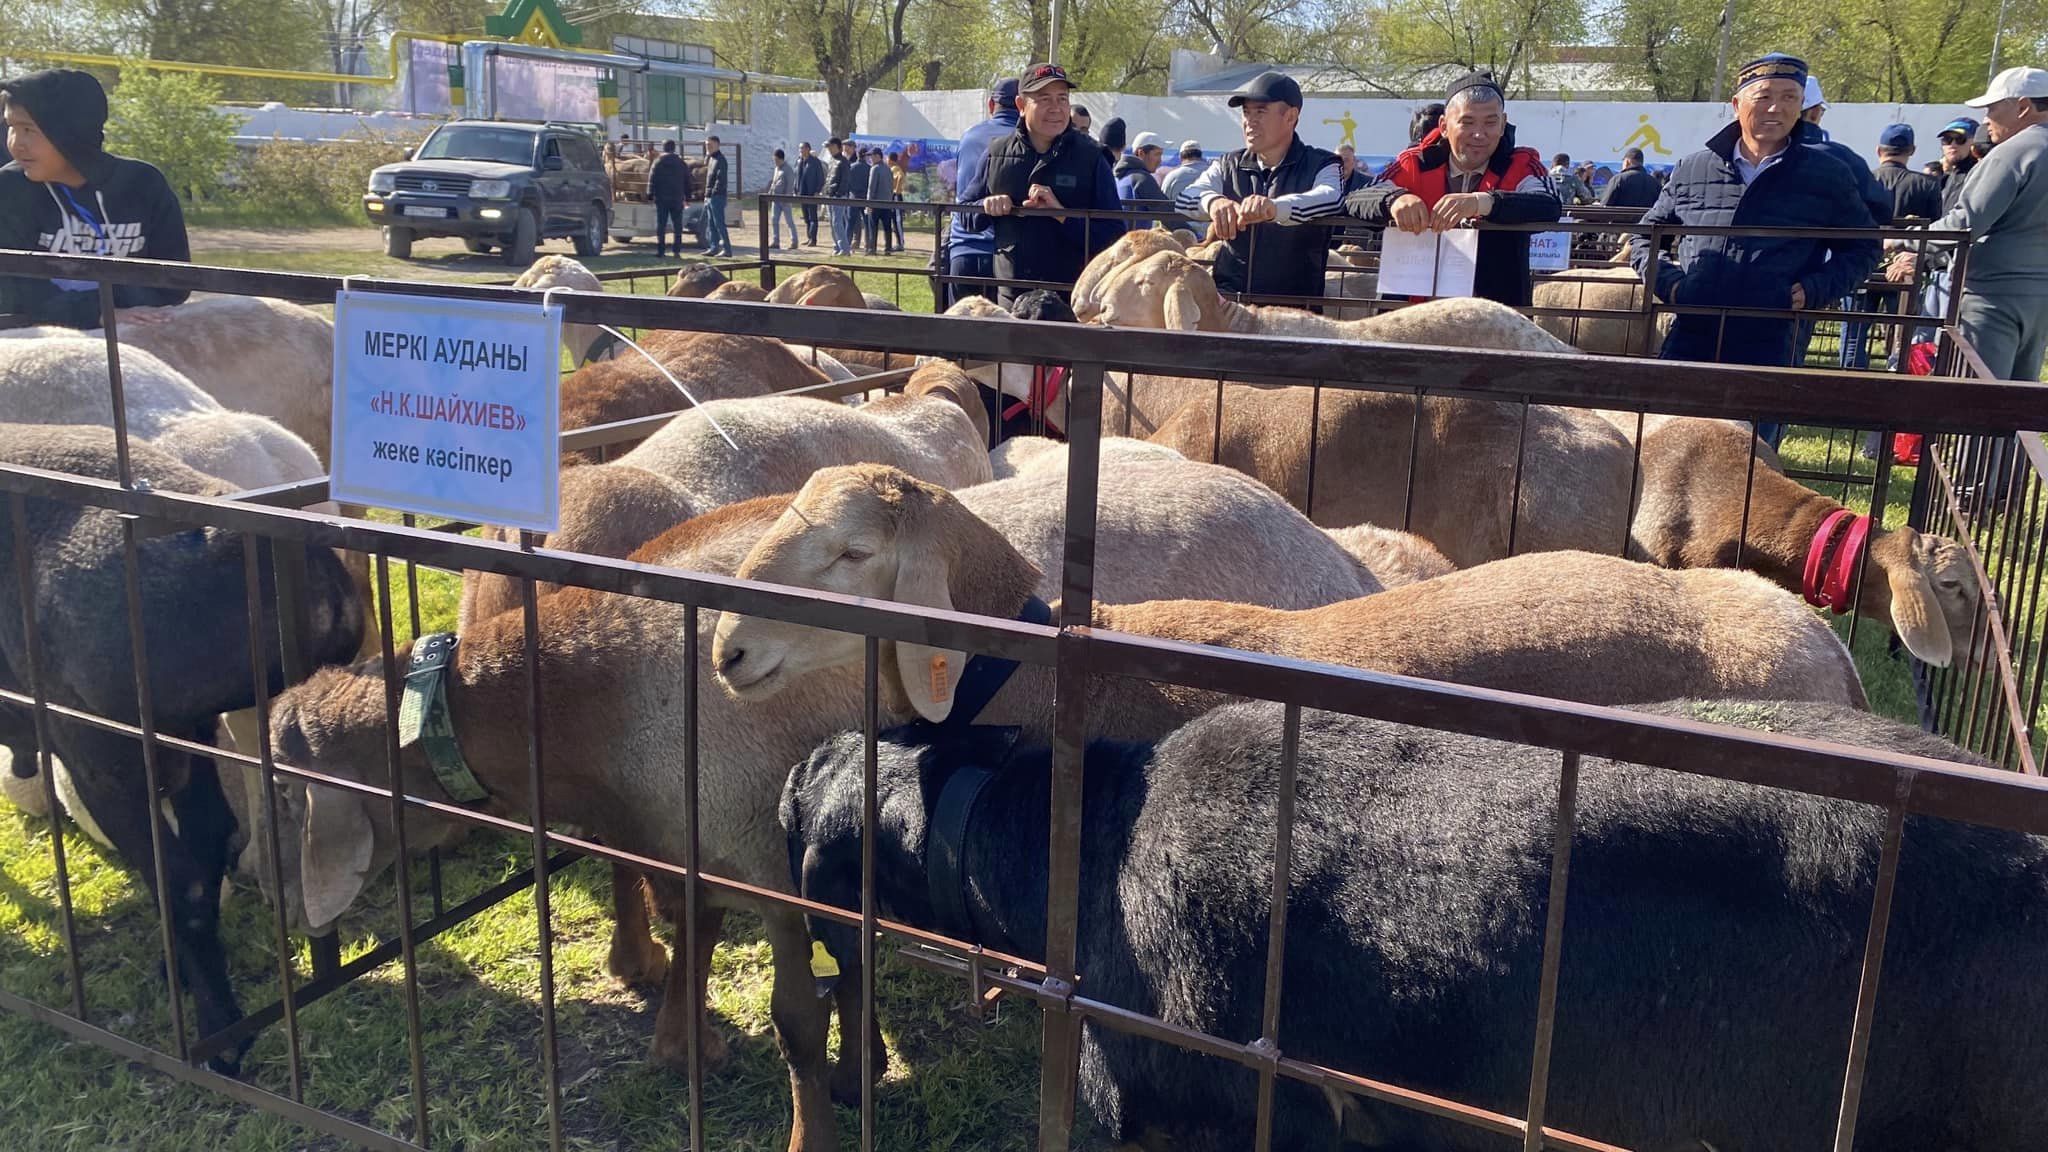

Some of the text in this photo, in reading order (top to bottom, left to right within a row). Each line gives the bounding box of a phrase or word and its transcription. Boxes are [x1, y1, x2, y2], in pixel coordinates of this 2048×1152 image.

[364, 330, 528, 372] МЕРКІ АУДАНЫ
[370, 390, 527, 431] «Н.К.ШАЙХИЕВ»
[373, 440, 513, 483] жеке кәсіпкер
